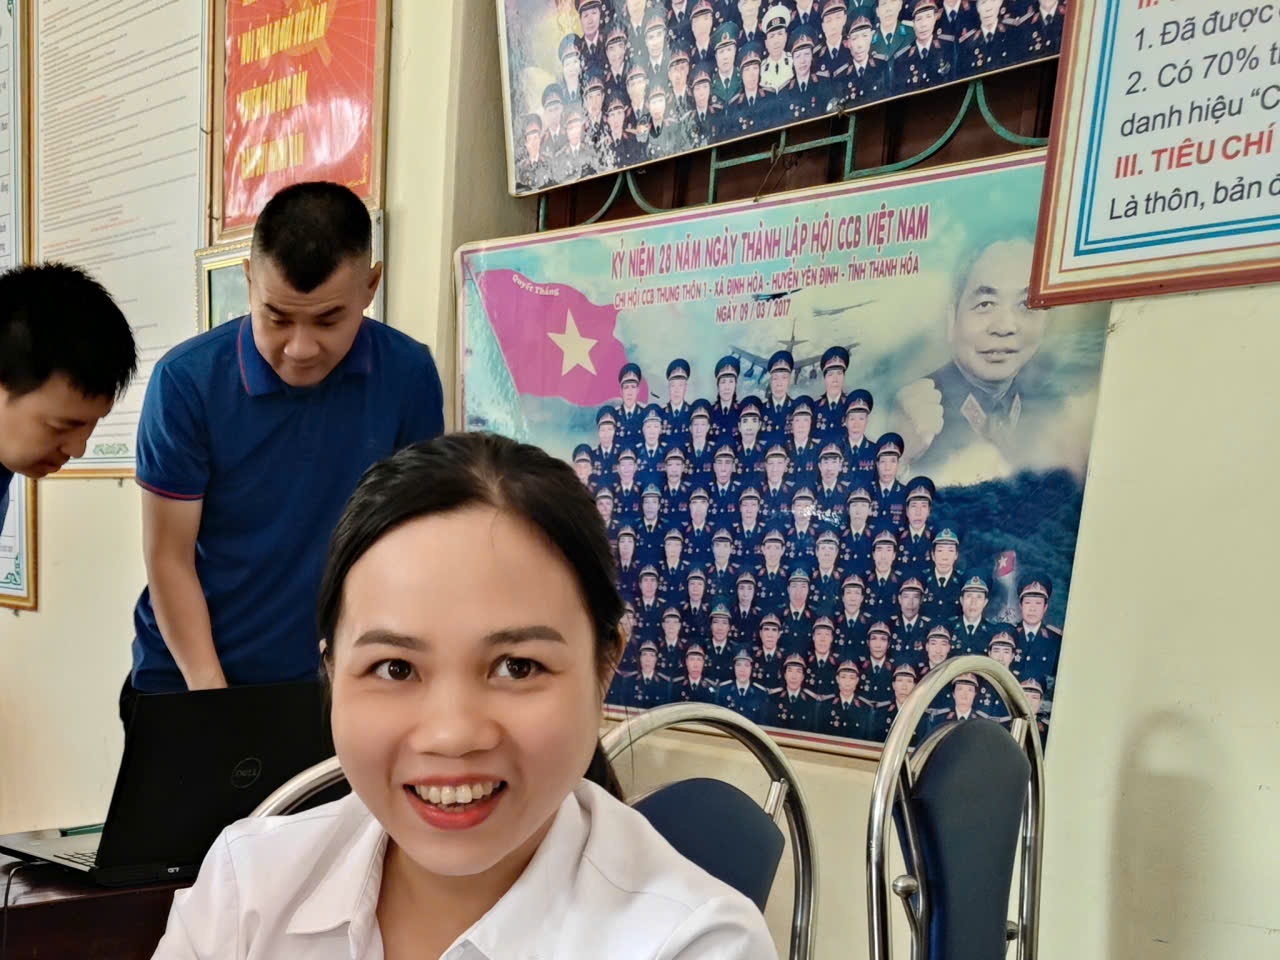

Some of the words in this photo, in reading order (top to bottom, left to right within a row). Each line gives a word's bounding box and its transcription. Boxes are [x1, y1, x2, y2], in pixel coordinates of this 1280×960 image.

[1135, 27, 1153, 51] 1.
[1160, 16, 1196, 46] Đã
[1202, 4, 1274, 33] được
[1125, 71, 1147, 95] 2.
[1157, 59, 1193, 88] Có
[1203, 45, 1259, 79] 70%
[1121, 104, 1182, 137] danh
[1188, 95, 1243, 125] hiệu
[1114, 153, 1143, 179] III.
[1152, 137, 1216, 172] TIÊU
[1221, 122, 1276, 160] CHÍ
[1109, 195, 1139, 220] Là
[1144, 187, 1205, 215] thôn,
[1212, 176, 1262, 204] bản
[628, 240, 655, 283] NIỆM
[659, 243, 672, 274] 28
[675, 233, 701, 271] NĂM
[705, 226, 738, 267] NGÀY
[741, 220, 782, 263] THÀNH
[785, 216, 808, 264] LẬP
[810, 211, 834, 260] HỘI
[837, 215, 861, 251] CCB
[867, 203, 895, 253] VIỆT
[896, 204, 929, 242] NAM
[682, 280, 701, 300] THÔN
[801, 264, 817, 286] YÊN
[869, 257, 898, 279] THANH
[716, 300, 737, 322] NGÀY
[773, 298, 791, 317] 2017
